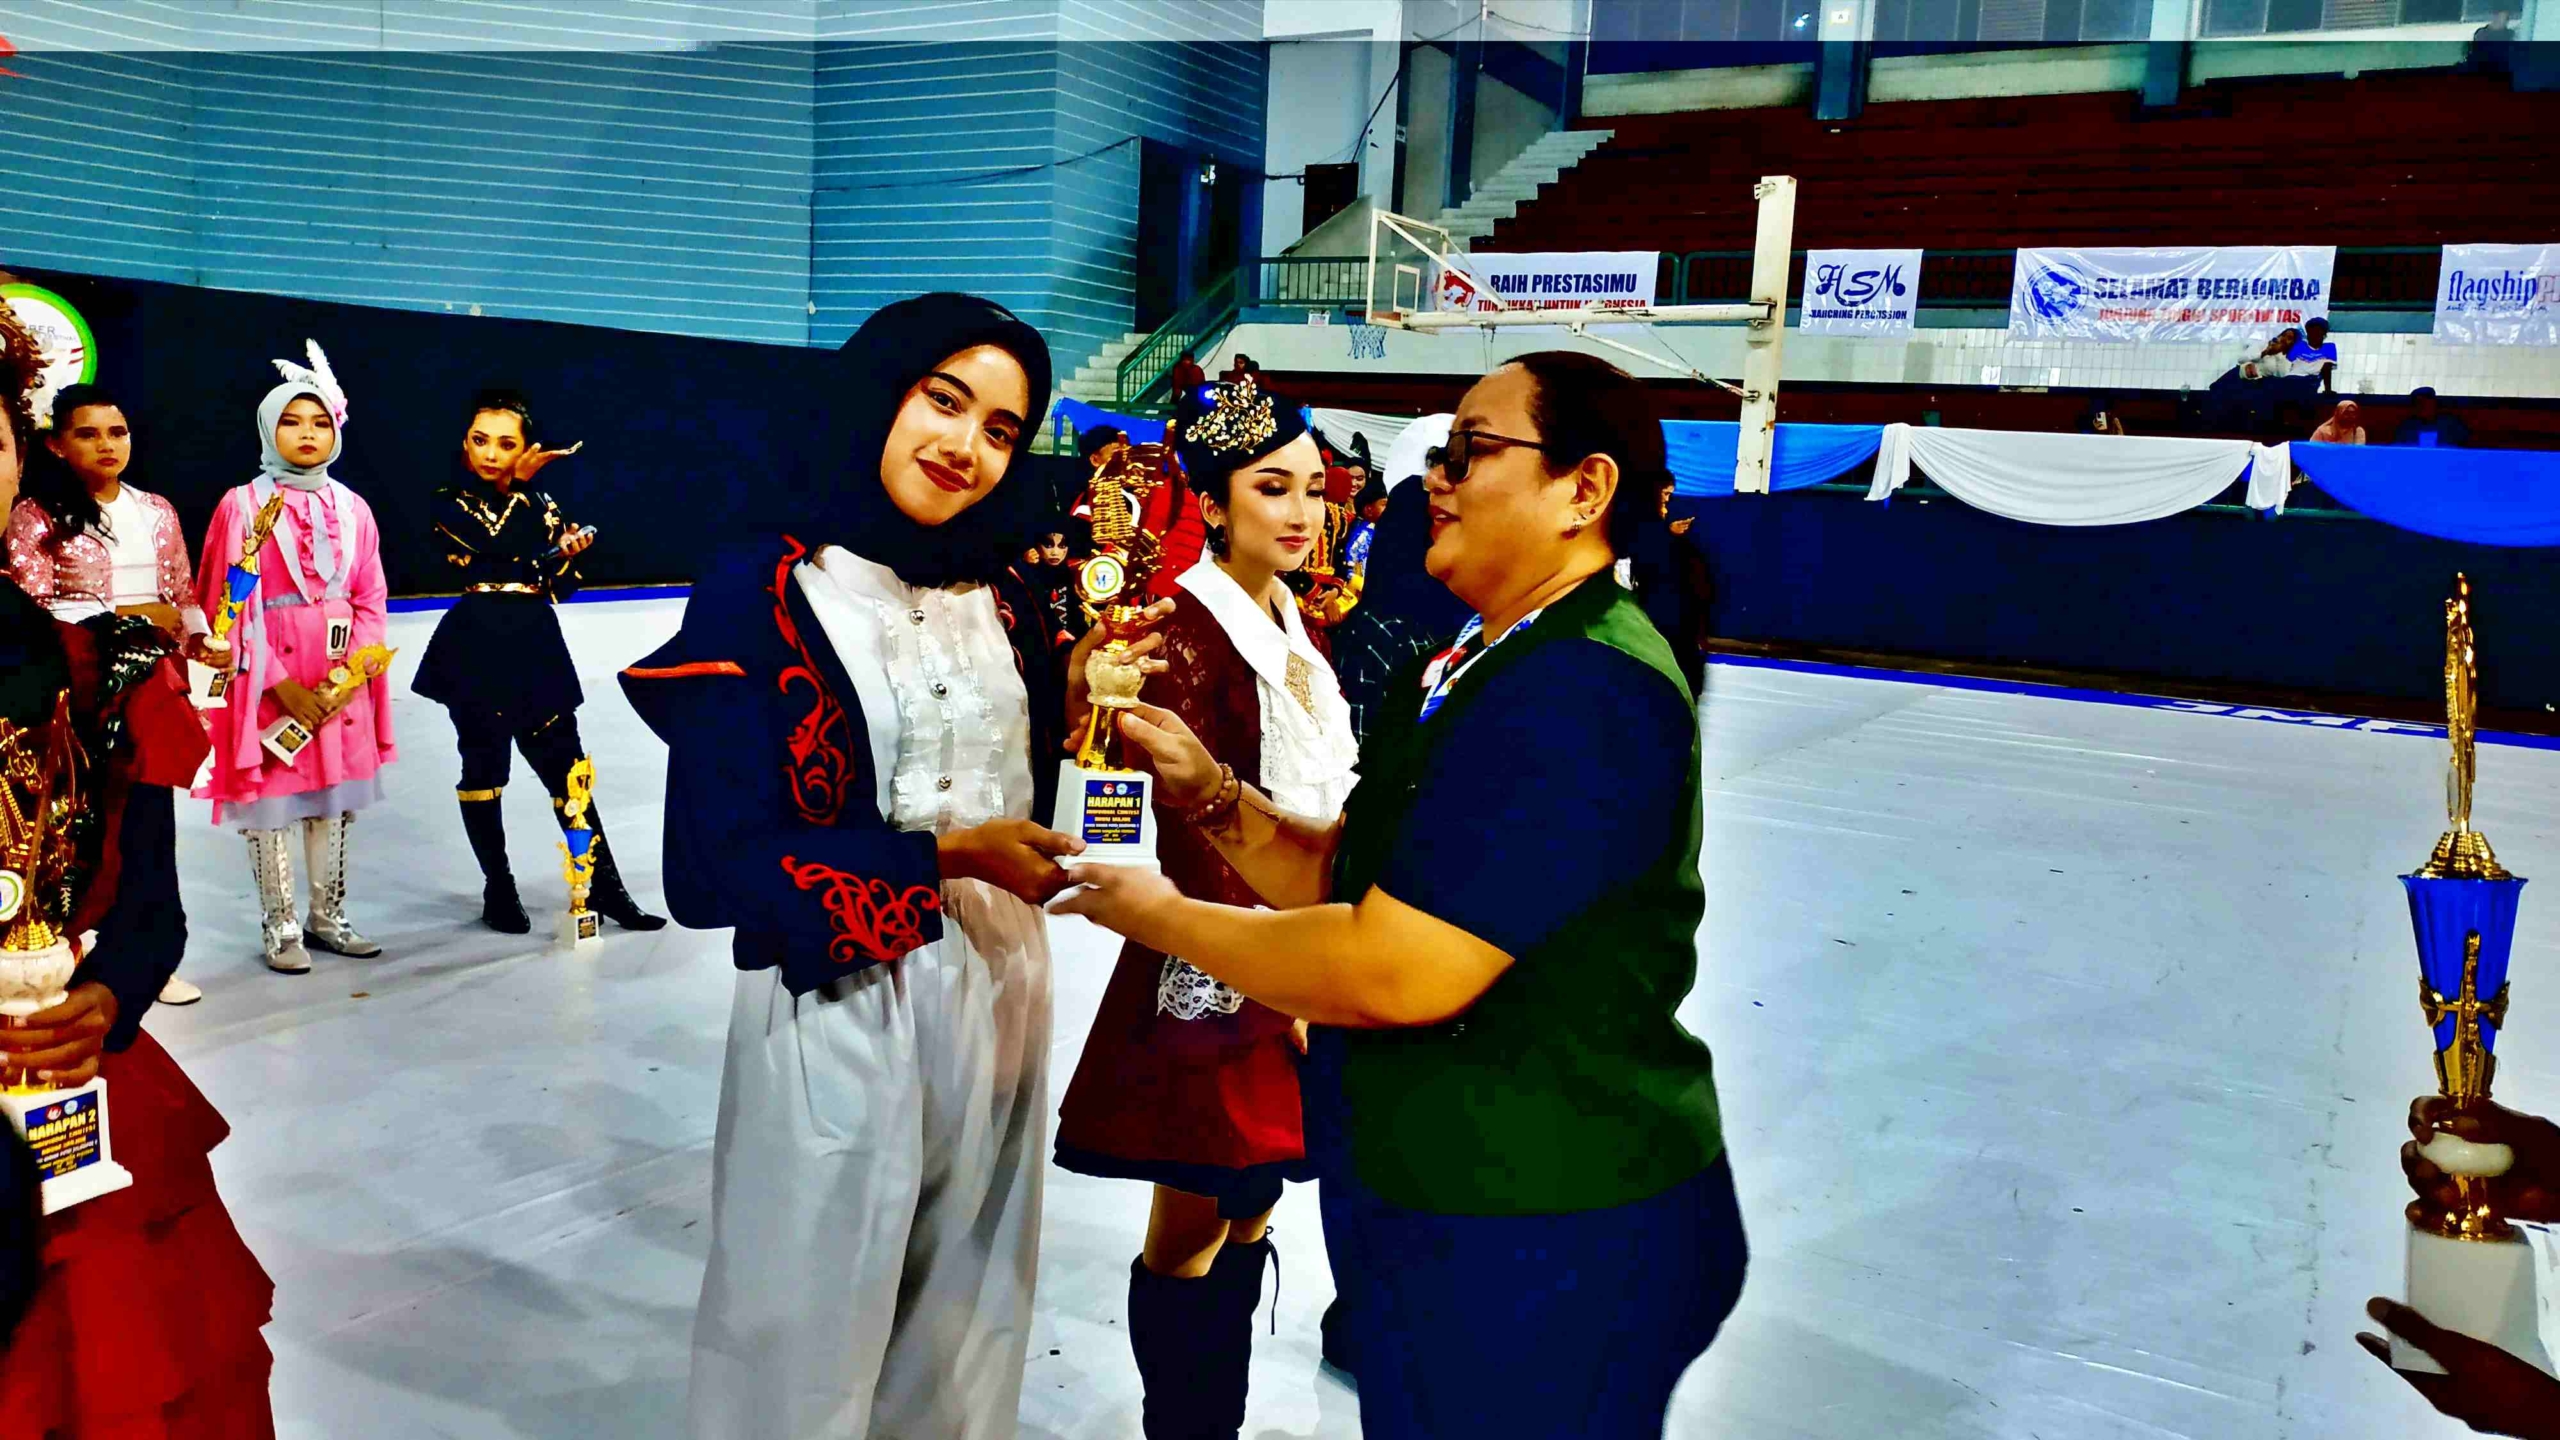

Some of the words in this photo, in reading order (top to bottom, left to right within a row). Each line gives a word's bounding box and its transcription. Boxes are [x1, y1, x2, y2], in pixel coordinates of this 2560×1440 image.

[1490, 274, 1528, 293] RAIH
[1531, 273, 1638, 293] PRESTASIMU
[1815, 263, 1907, 307] HSM
[2093, 277, 2191, 300] SELAMAT
[2196, 277, 2321, 301] BERLOMBA
[330, 625, 348, 649] 01
[1087, 796, 1134, 808] HARAPAN
[1135, 797, 1141, 808] 1
[28, 1112, 86, 1141] HARAPAN
[88, 1109, 96, 1123] 2
